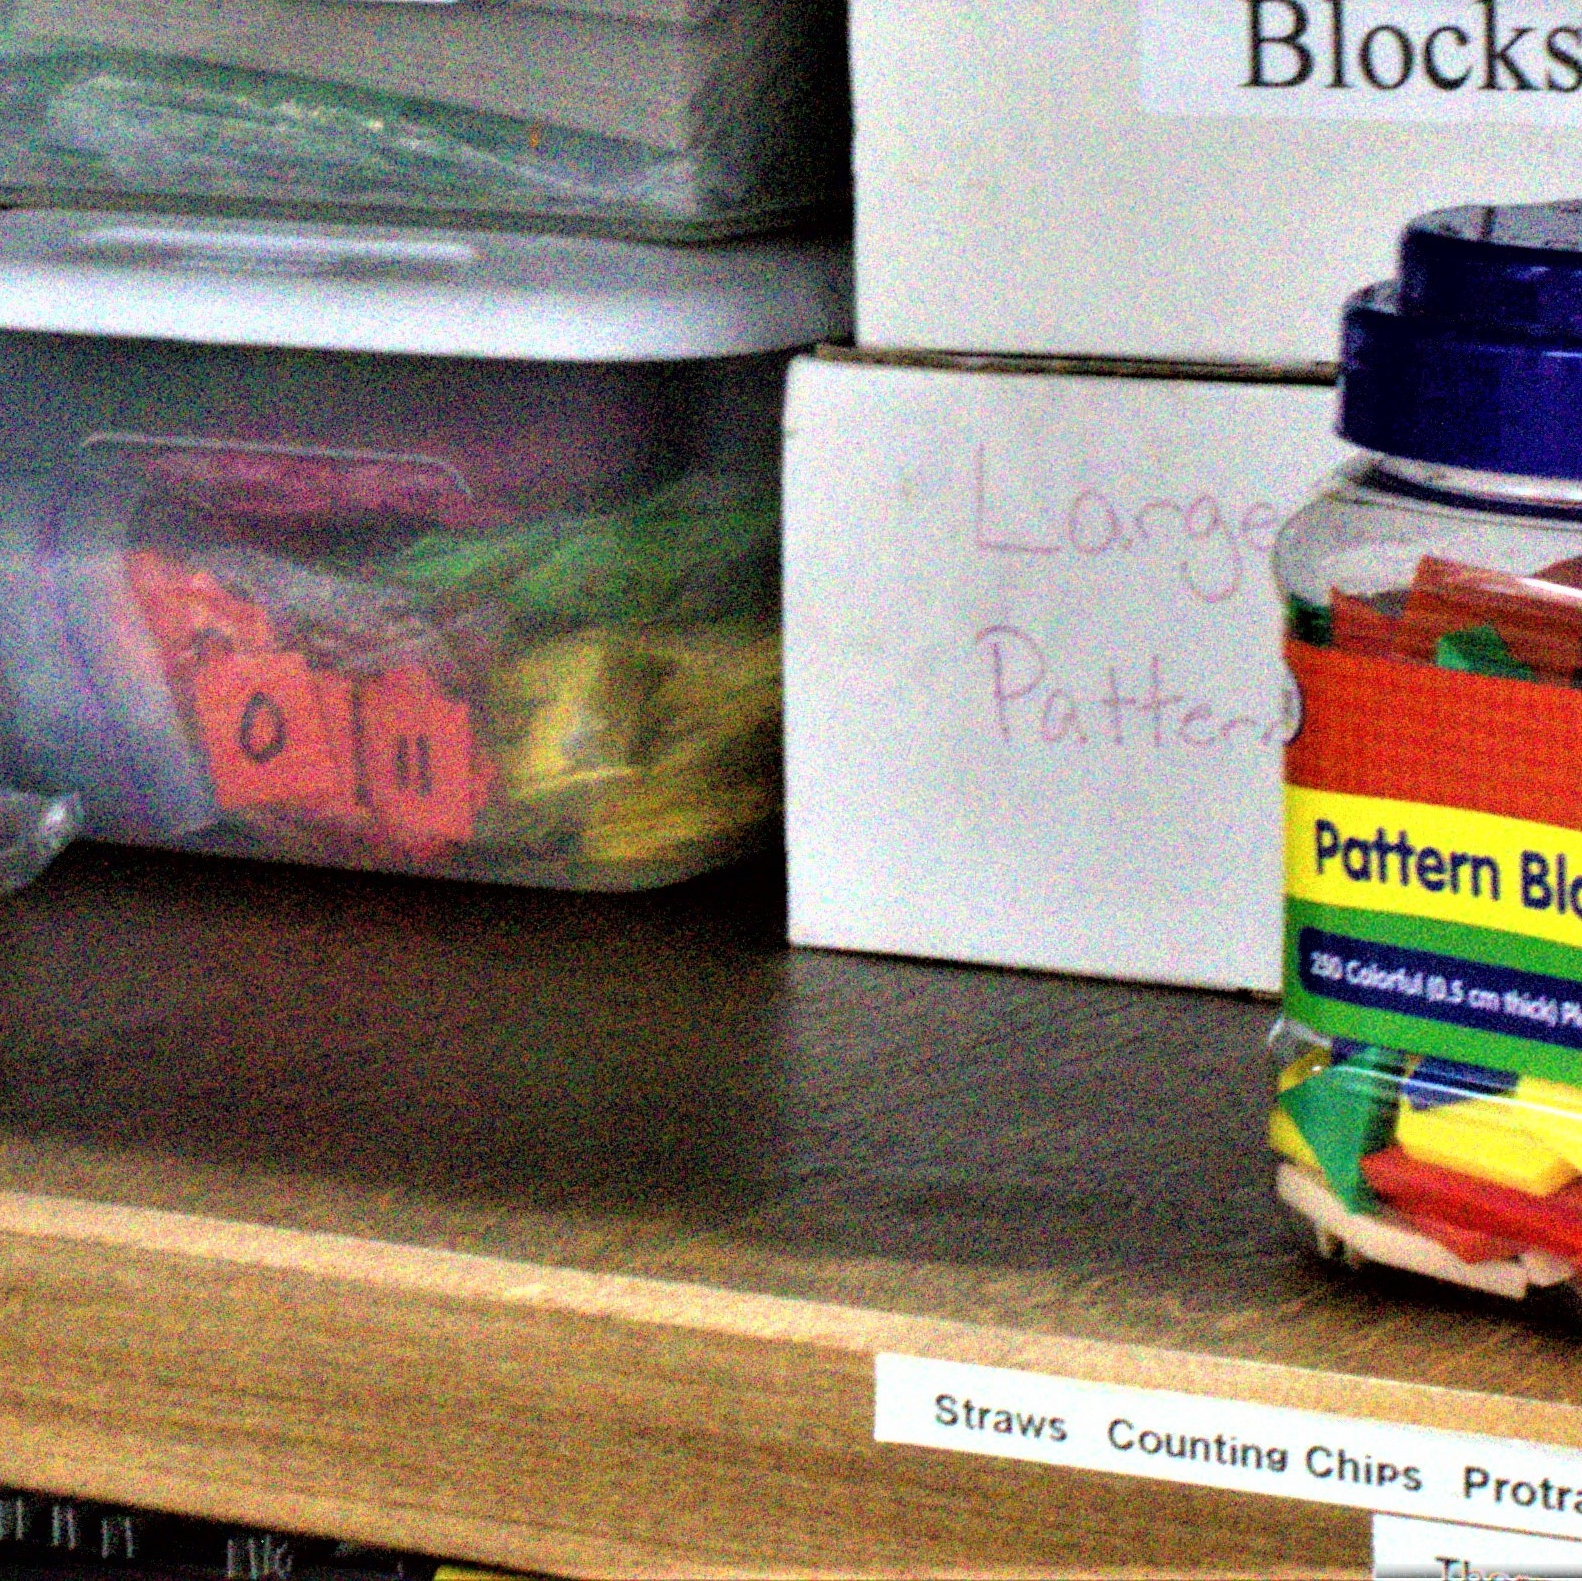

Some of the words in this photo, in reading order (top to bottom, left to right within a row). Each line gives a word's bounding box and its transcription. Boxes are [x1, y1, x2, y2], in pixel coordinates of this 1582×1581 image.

[975, 441, 1278, 603] Large
[1315, 820, 1502, 900] Pattern
[1346, 959, 1423, 996] Colorful
[1468, 987, 1501, 1012] cm
[934, 1393, 1068, 1443] Straws
[1107, 1417, 1290, 1473] Counting
[1305, 1444, 1424, 1493] Chips
